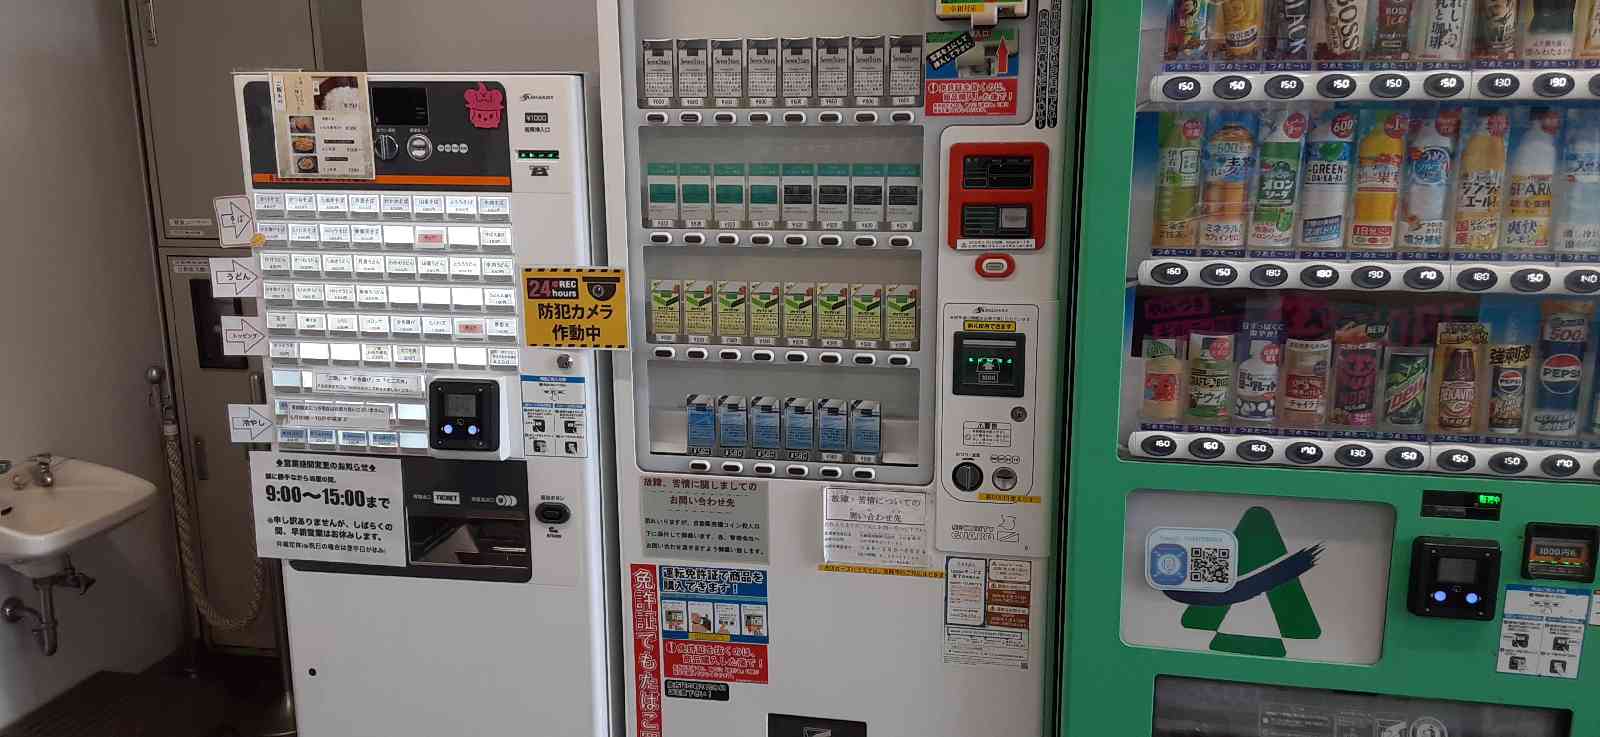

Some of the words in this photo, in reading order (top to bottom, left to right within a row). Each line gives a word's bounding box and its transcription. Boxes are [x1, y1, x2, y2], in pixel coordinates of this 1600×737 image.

[226, 273, 250, 281] うどん
[559, 280, 577, 288] REC
[552, 289, 577, 297] hours
[538, 303, 613, 320] 防犯カメラ
[552, 324, 601, 342] 作動中
[663, 567, 764, 584] 運転免許証で商品を
